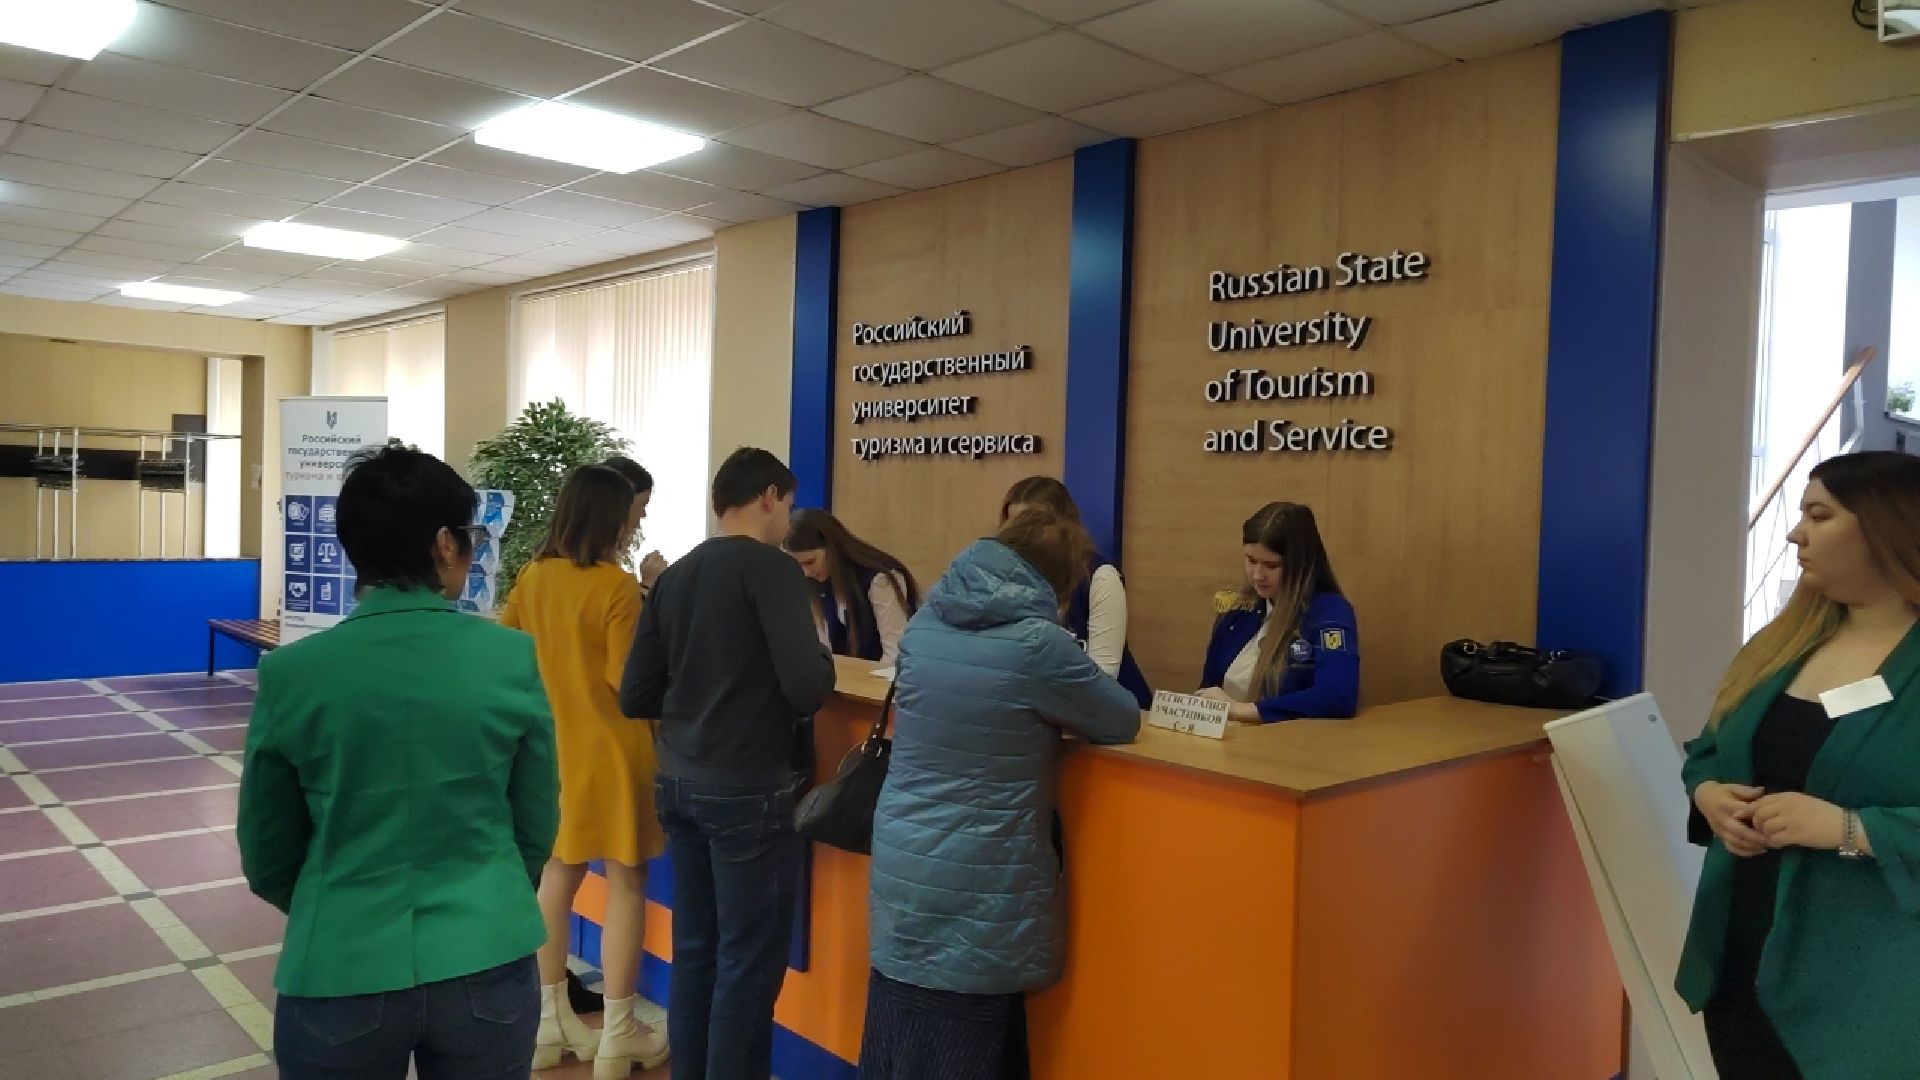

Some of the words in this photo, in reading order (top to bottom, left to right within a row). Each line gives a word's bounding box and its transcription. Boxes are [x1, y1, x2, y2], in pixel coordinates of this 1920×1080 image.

[1209, 263, 1323, 300] Russian
[1335, 250, 1425, 286] State
[852, 310, 965, 345] Российский
[1208, 310, 1367, 351] University
[852, 345, 1026, 386] государственный
[1205, 369, 1237, 402] of
[1239, 366, 1369, 401] Tourism
[851, 395, 971, 424] университет
[302, 434, 362, 444] Российский
[851, 436, 925, 460] туризма
[931, 437, 943, 454] и
[948, 434, 1034, 460] сервиса
[1203, 420, 1259, 451] and
[1269, 418, 1388, 451] Service
